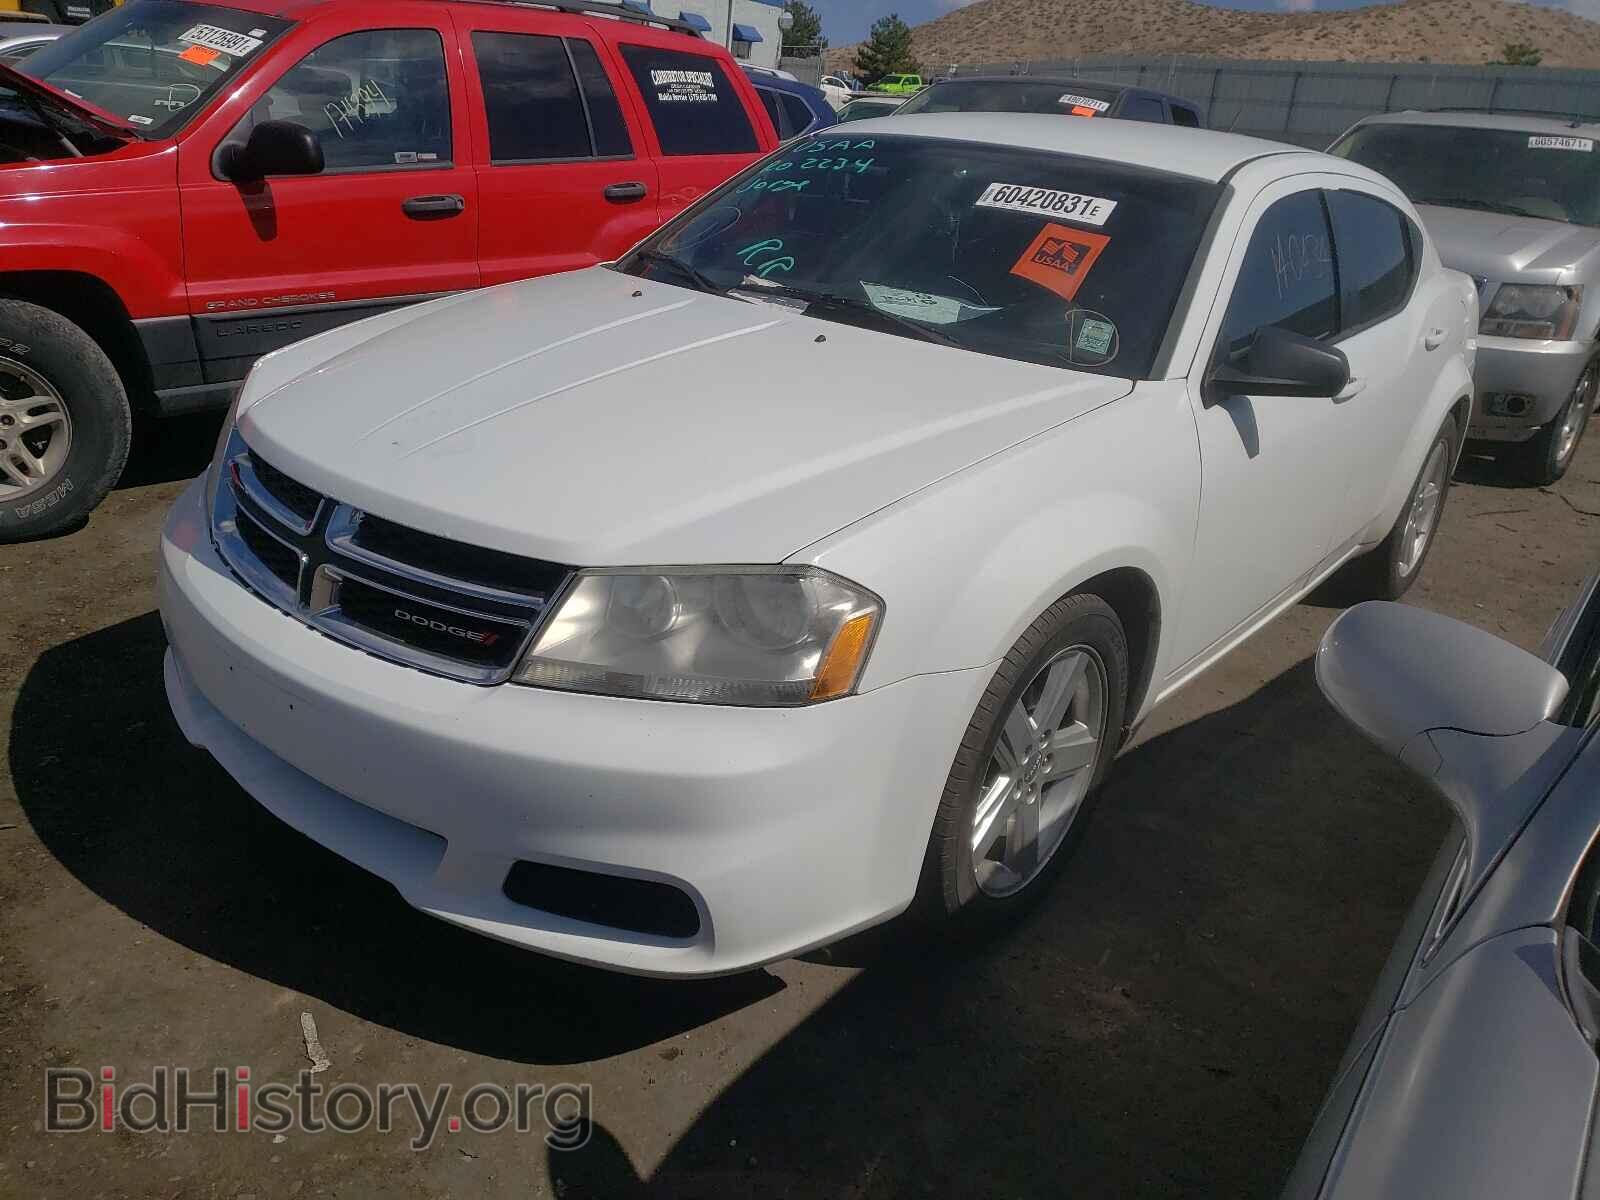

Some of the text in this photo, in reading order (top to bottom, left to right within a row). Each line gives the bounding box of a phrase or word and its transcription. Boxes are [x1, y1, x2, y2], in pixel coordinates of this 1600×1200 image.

[1034, 254, 1070, 272] USAA
[16, 479, 74, 518] MESA
[394, 609, 485, 642] DODGE
